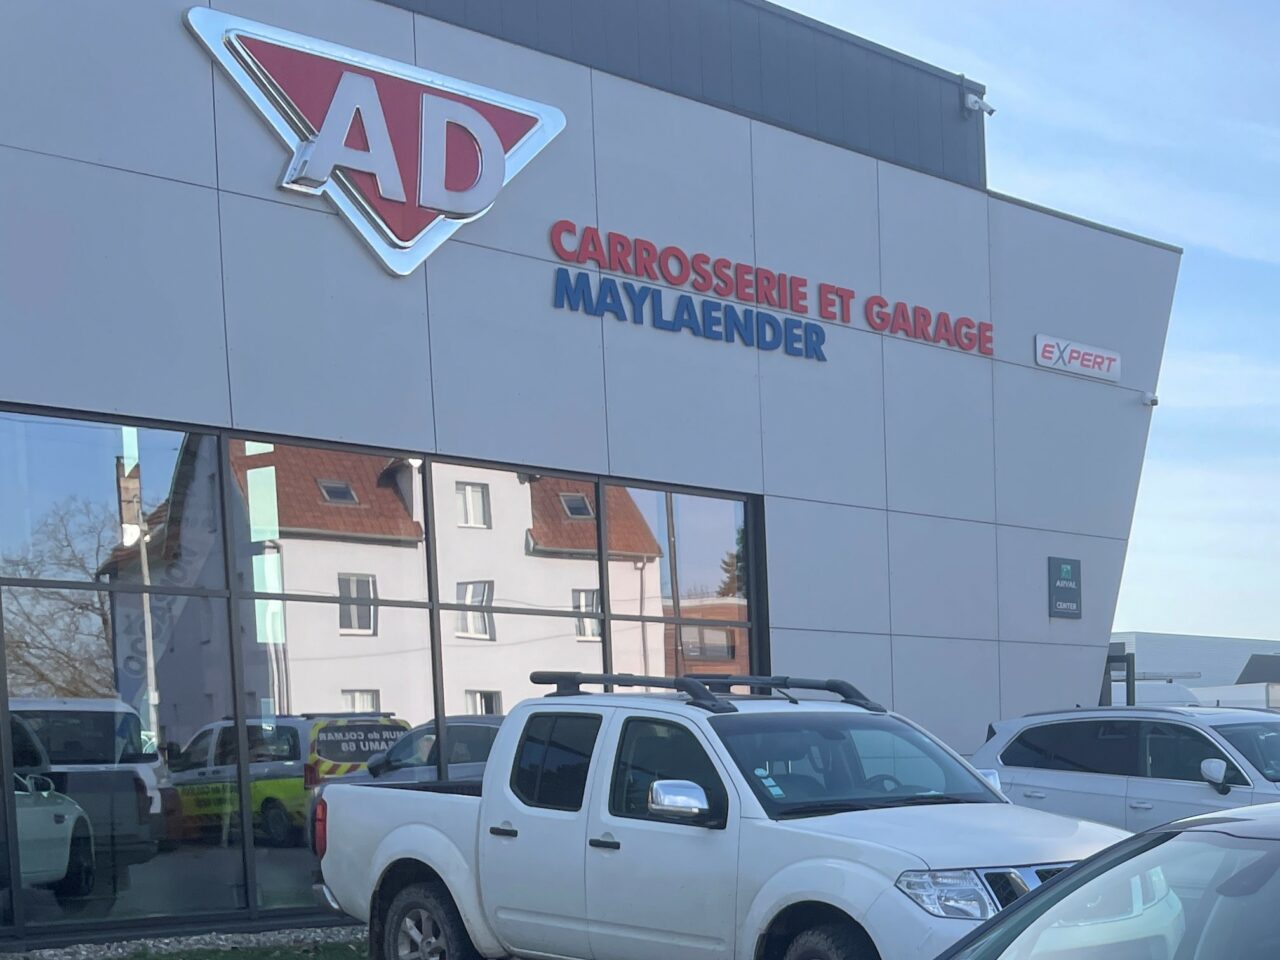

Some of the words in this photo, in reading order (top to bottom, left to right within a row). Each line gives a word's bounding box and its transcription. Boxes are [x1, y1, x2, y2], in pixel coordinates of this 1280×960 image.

[290, 70, 506, 216] AD
[551, 219, 808, 314] CARROSSERIE
[818, 282, 855, 323] ET
[865, 295, 994, 356] GARAGE
[553, 267, 827, 362] MAYLAENDER
